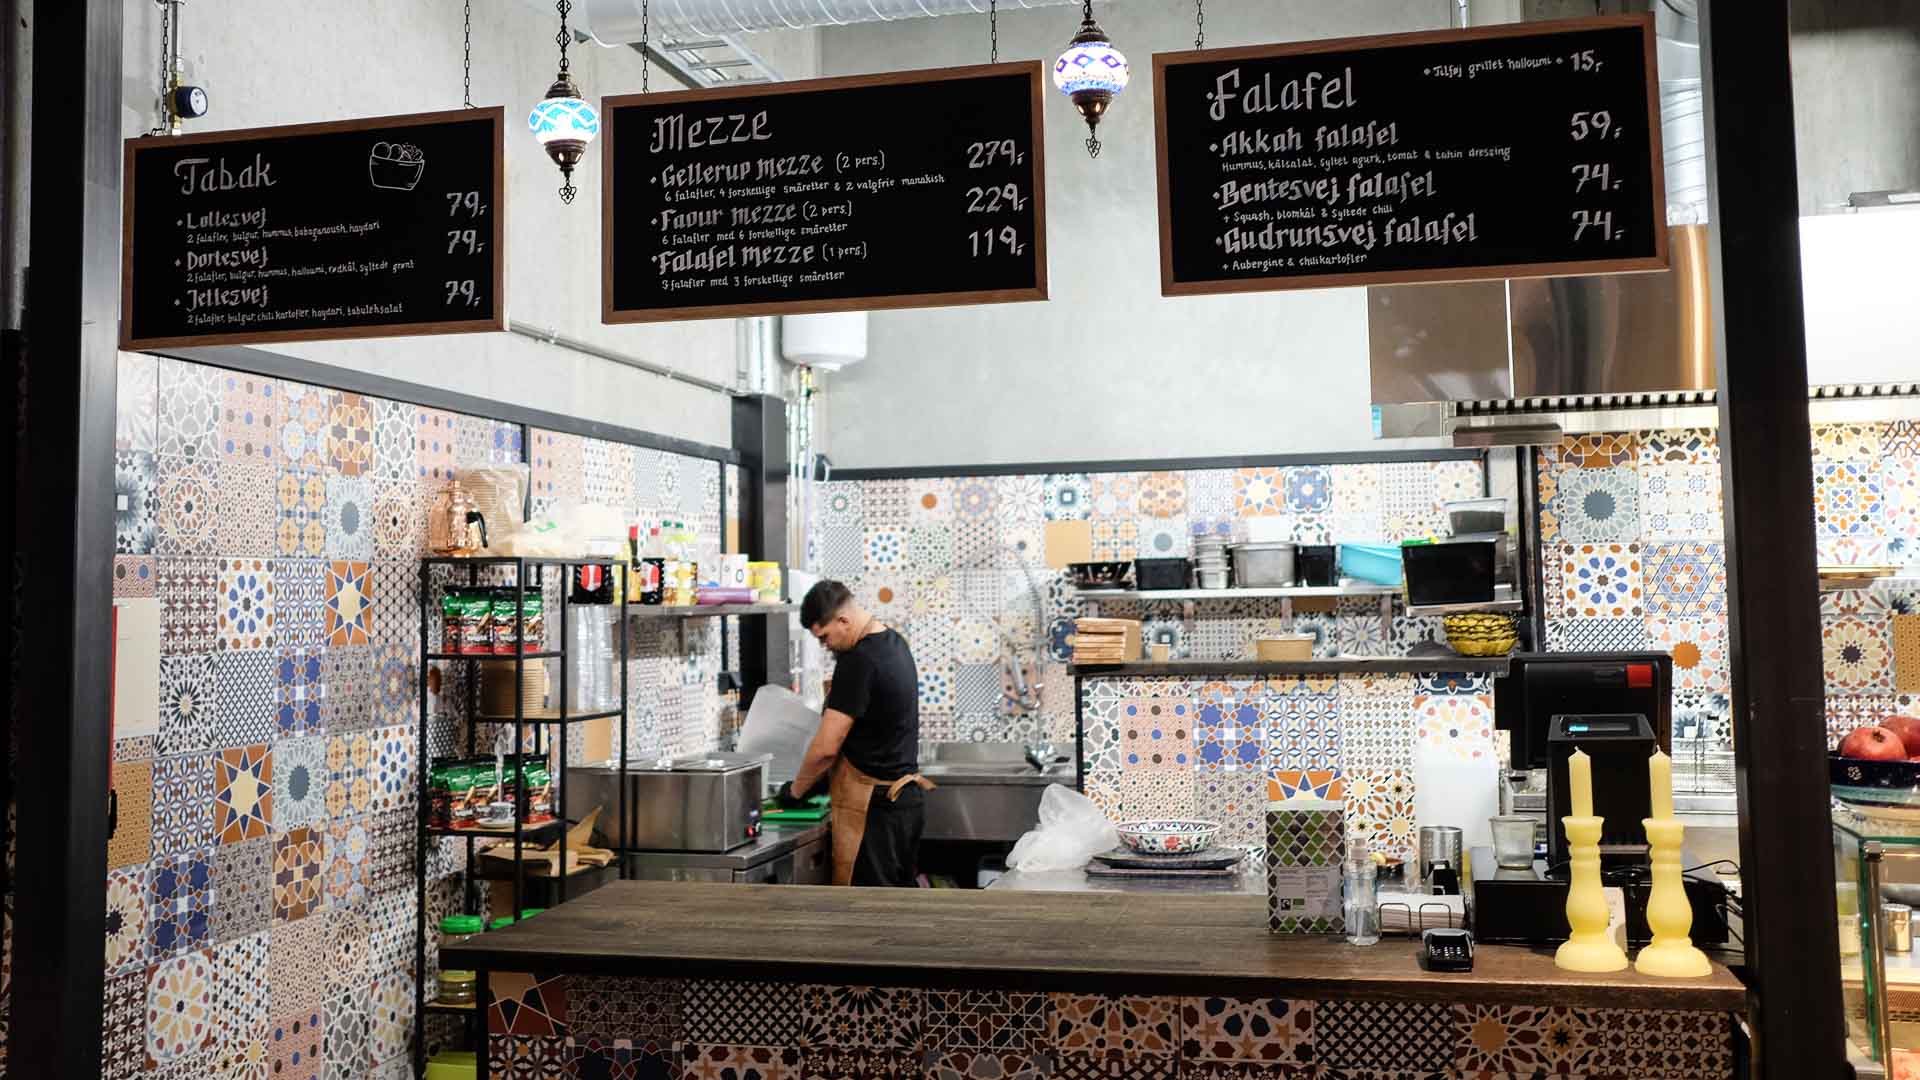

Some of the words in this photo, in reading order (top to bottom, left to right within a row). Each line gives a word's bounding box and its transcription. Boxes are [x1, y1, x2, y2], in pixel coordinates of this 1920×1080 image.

[1468, 58, 1504, 79] grillet
[1506, 55, 1552, 71] halloumi
[1207, 66, 1357, 121] Falafel
[650, 110, 772, 153] Mezze
[1220, 126, 1303, 158] Akkah
[1314, 120, 1400, 152] falafel
[1387, 150, 1418, 163] tomat
[1468, 147, 1511, 162] dressing
[175, 153, 278, 195] Tabak
[662, 162, 752, 188] Gellerup
[755, 154, 824, 181] mezze
[664, 191, 672, 202] 6
[728, 184, 776, 199] forskellige
[846, 182, 854, 191] 2
[857, 178, 895, 194] valgfrie
[1218, 177, 1341, 211] Bentesvej
[1346, 170, 1437, 205] falafel
[730, 203, 797, 227] mezze
[187, 234, 194, 243] 2
[662, 235, 669, 245] 6
[716, 230, 735, 242] med
[738, 229, 745, 241] 6
[1224, 220, 1377, 254] Gudrunsvej
[1383, 212, 1479, 248] falafel
[658, 244, 737, 276] Falafel
[741, 244, 815, 268] mezze
[1232, 258, 1284, 272] Aubergine
[186, 273, 194, 282] 2
[710, 275, 728, 288] med
[733, 276, 740, 287] 3
[187, 314, 194, 323] 2
